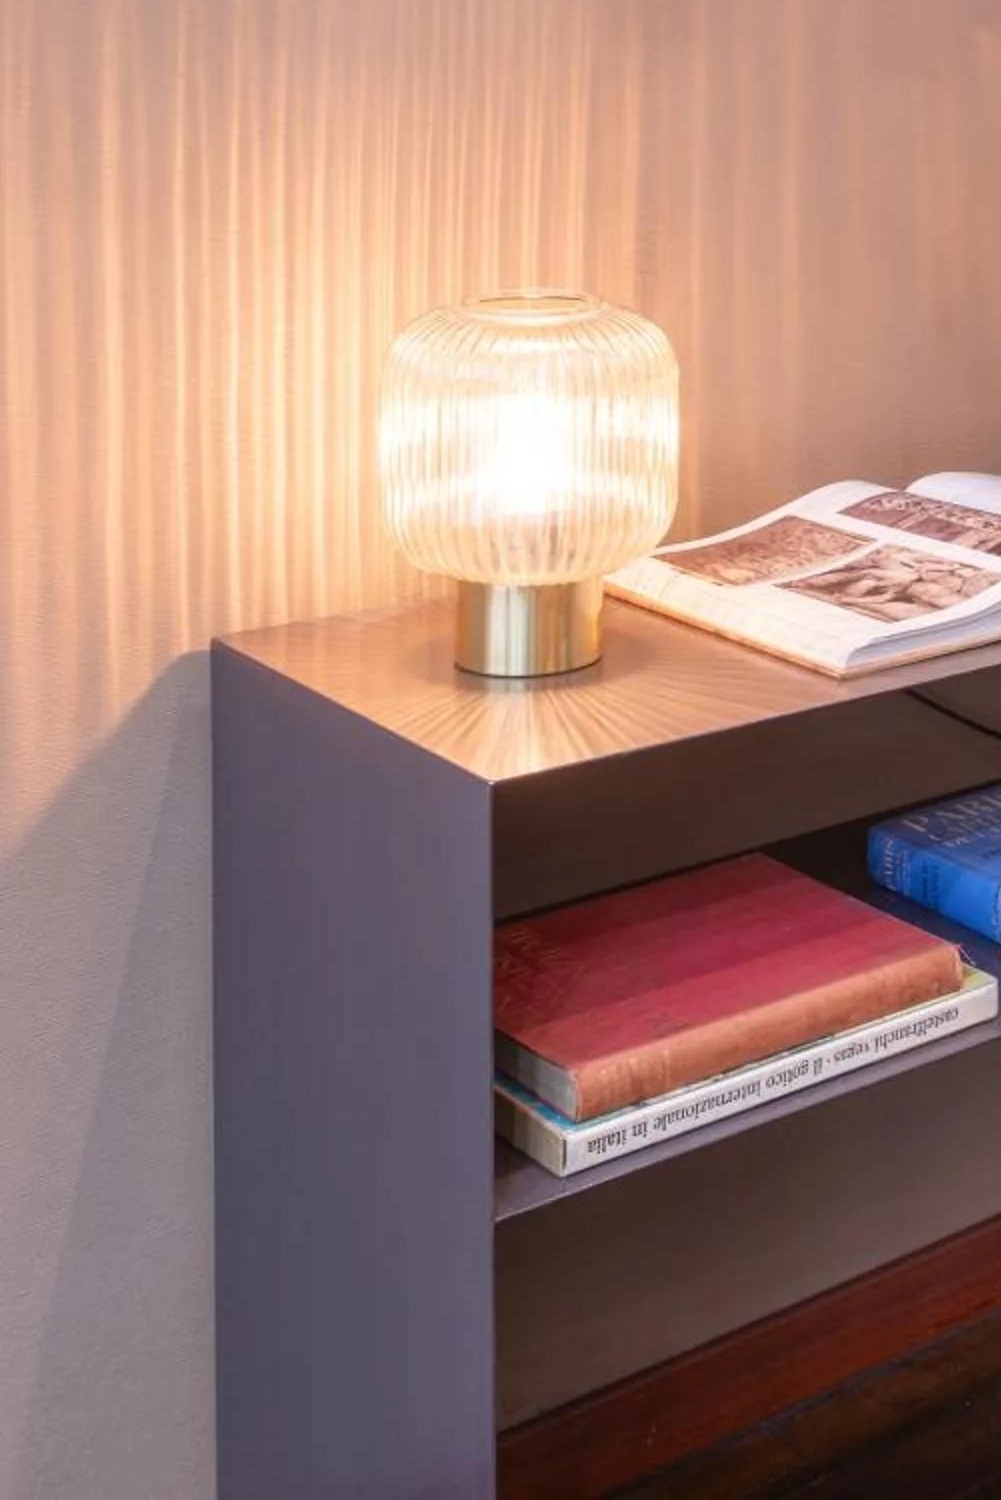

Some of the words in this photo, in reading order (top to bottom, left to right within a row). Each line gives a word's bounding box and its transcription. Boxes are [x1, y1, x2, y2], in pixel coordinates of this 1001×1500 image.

[765, 1059, 810, 1088] gotico
[653, 1075, 761, 1132] internazionale
[632, 1120, 649, 1137] in
[587, 1131, 627, 1155] italia
